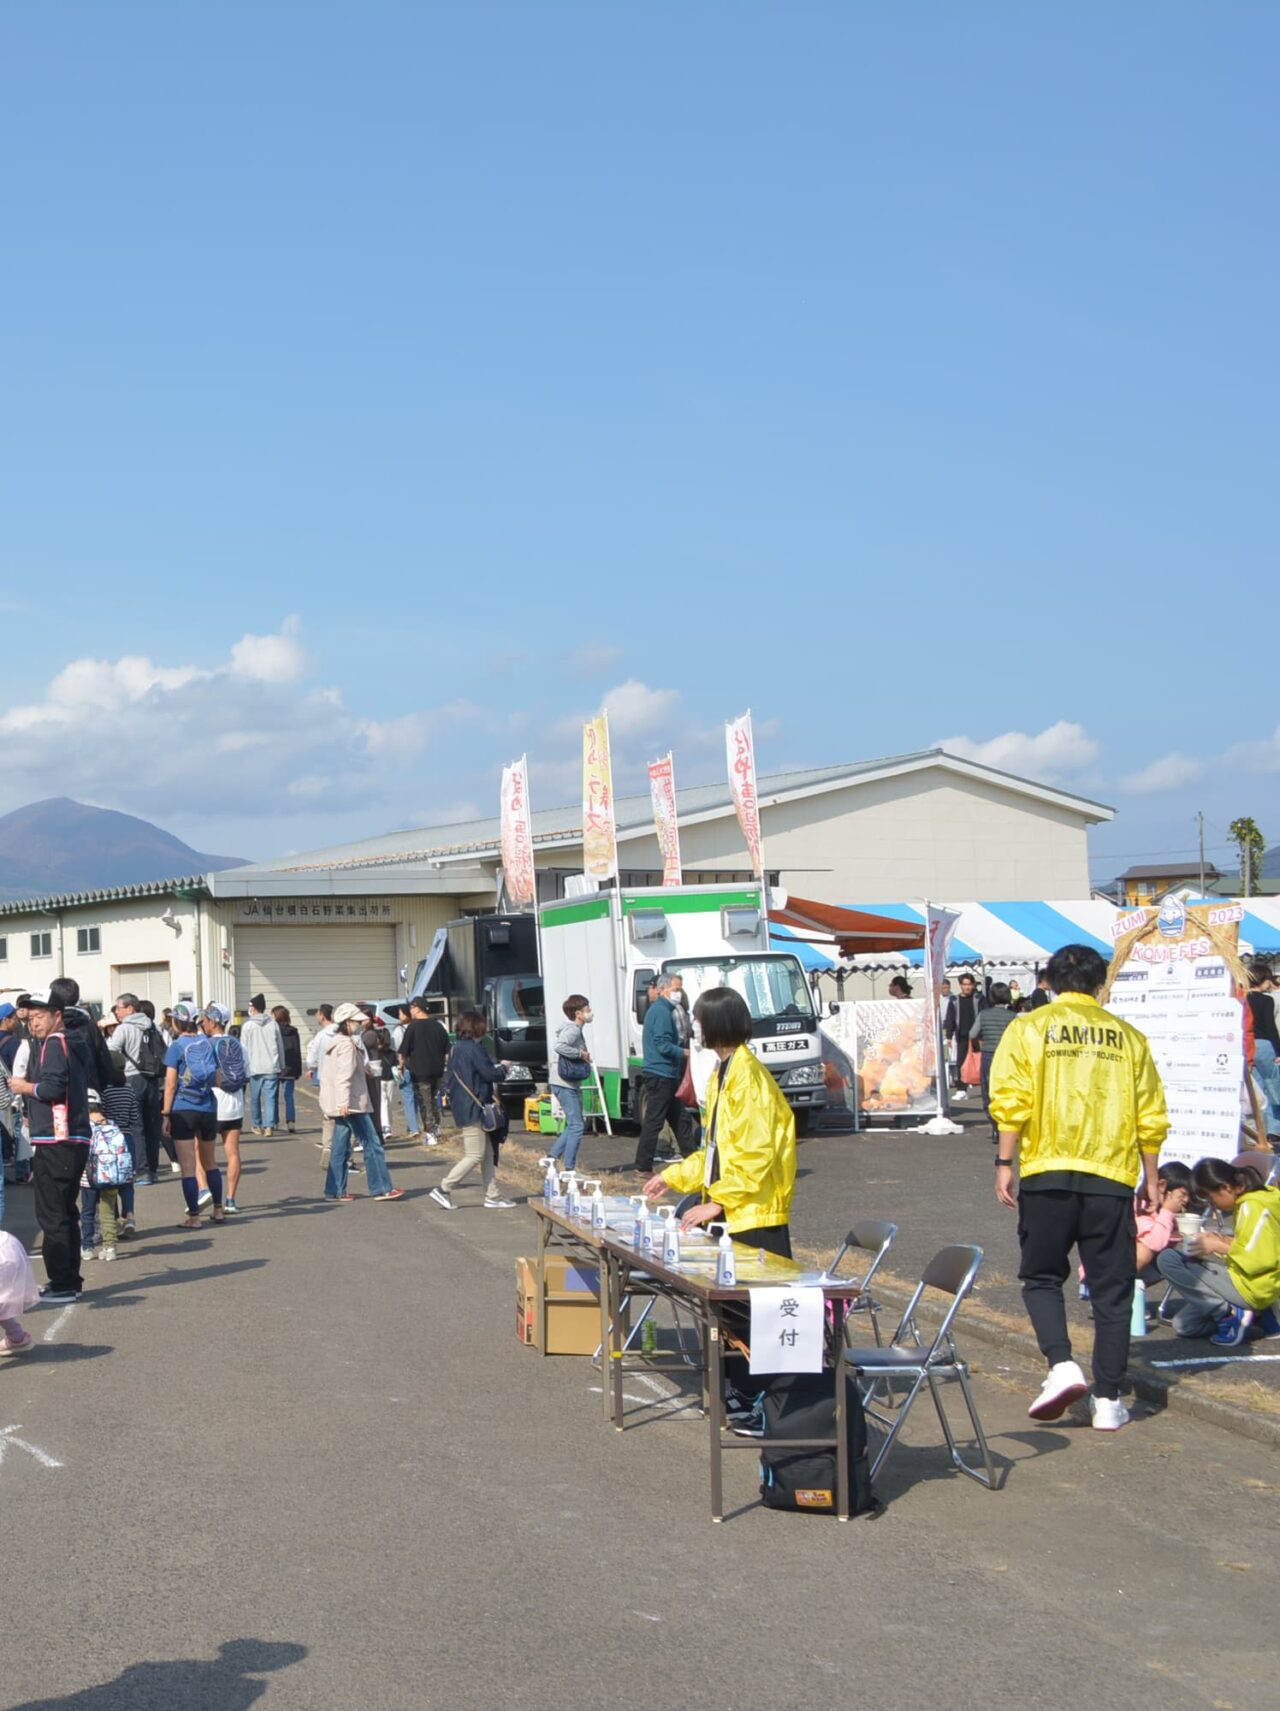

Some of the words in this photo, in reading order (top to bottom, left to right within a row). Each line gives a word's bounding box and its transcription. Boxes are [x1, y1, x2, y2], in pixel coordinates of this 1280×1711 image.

[1110, 911, 1147, 937] IZUMI
[1209, 907, 1243, 925] 2023
[1132, 941, 1210, 961] KOMEFES
[766, 1040, 806, 1052] 高圧ガス
[1045, 1024, 1124, 1050] KAMURI
[778, 1298, 800, 1348] 受付
